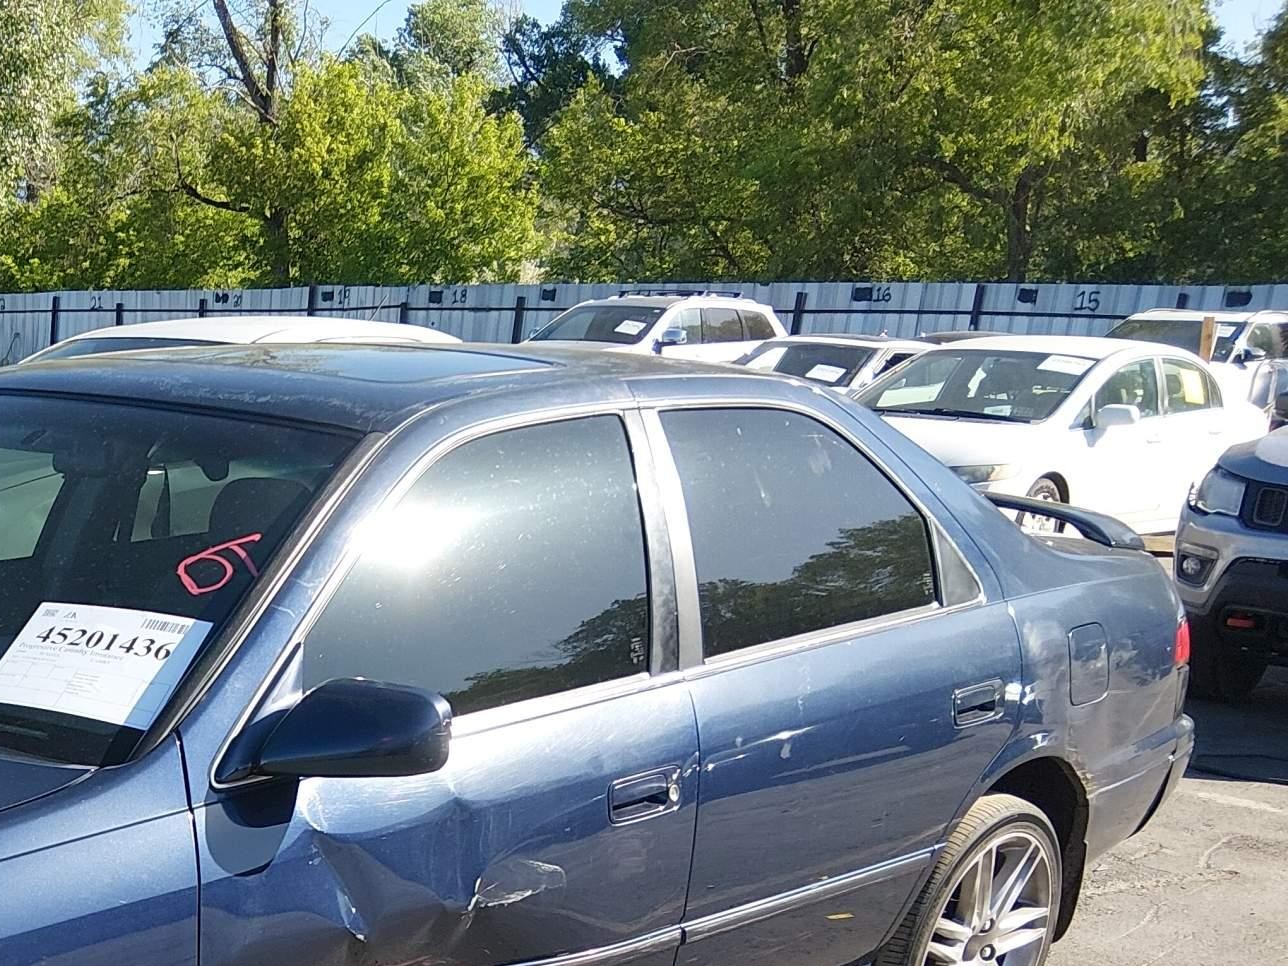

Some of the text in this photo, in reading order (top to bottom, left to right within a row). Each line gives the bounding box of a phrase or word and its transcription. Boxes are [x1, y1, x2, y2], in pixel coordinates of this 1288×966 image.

[452, 288, 468, 304] 18
[873, 287, 892, 302] 16
[1074, 291, 1101, 312] 15
[36, 624, 177, 661] 45201436
